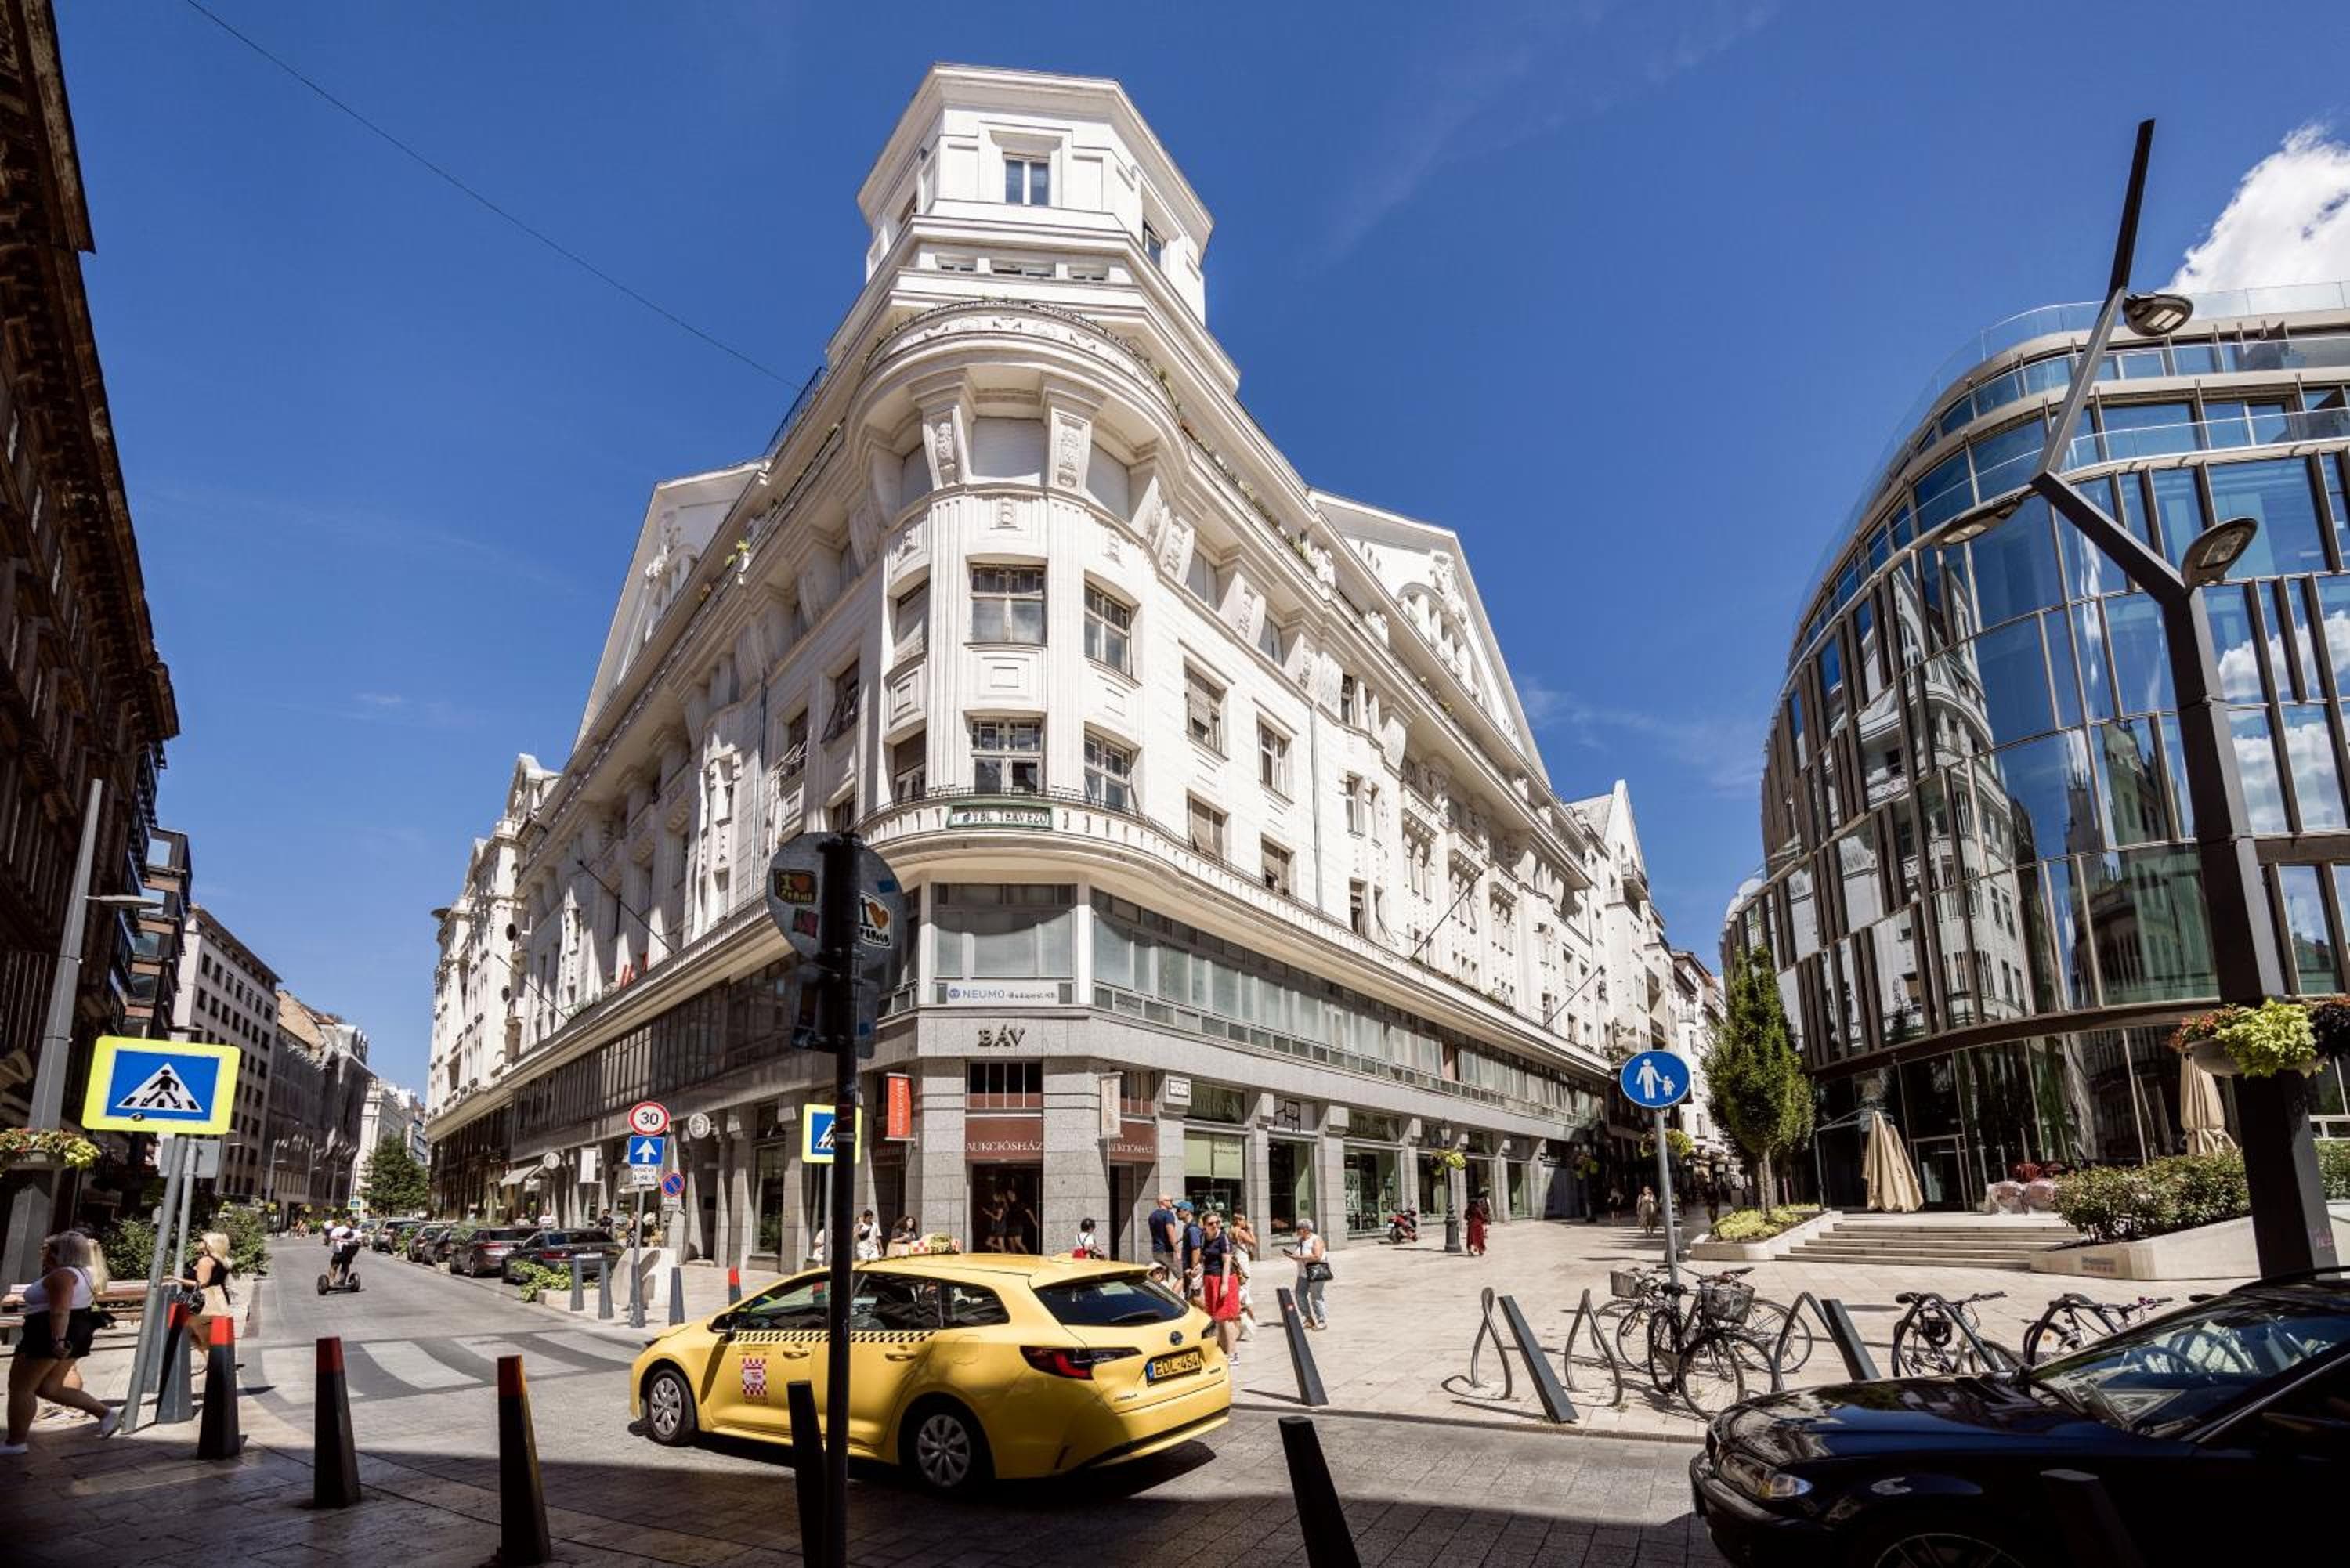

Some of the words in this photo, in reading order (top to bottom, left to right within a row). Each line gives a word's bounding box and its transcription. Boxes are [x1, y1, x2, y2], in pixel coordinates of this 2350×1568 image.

[962, 989, 1005, 999] NEUMO
[978, 1024, 1025, 1046] BÁV
[640, 1112, 659, 1125] 30
[966, 1140, 1043, 1152] AUKCIÓSHÁZ
